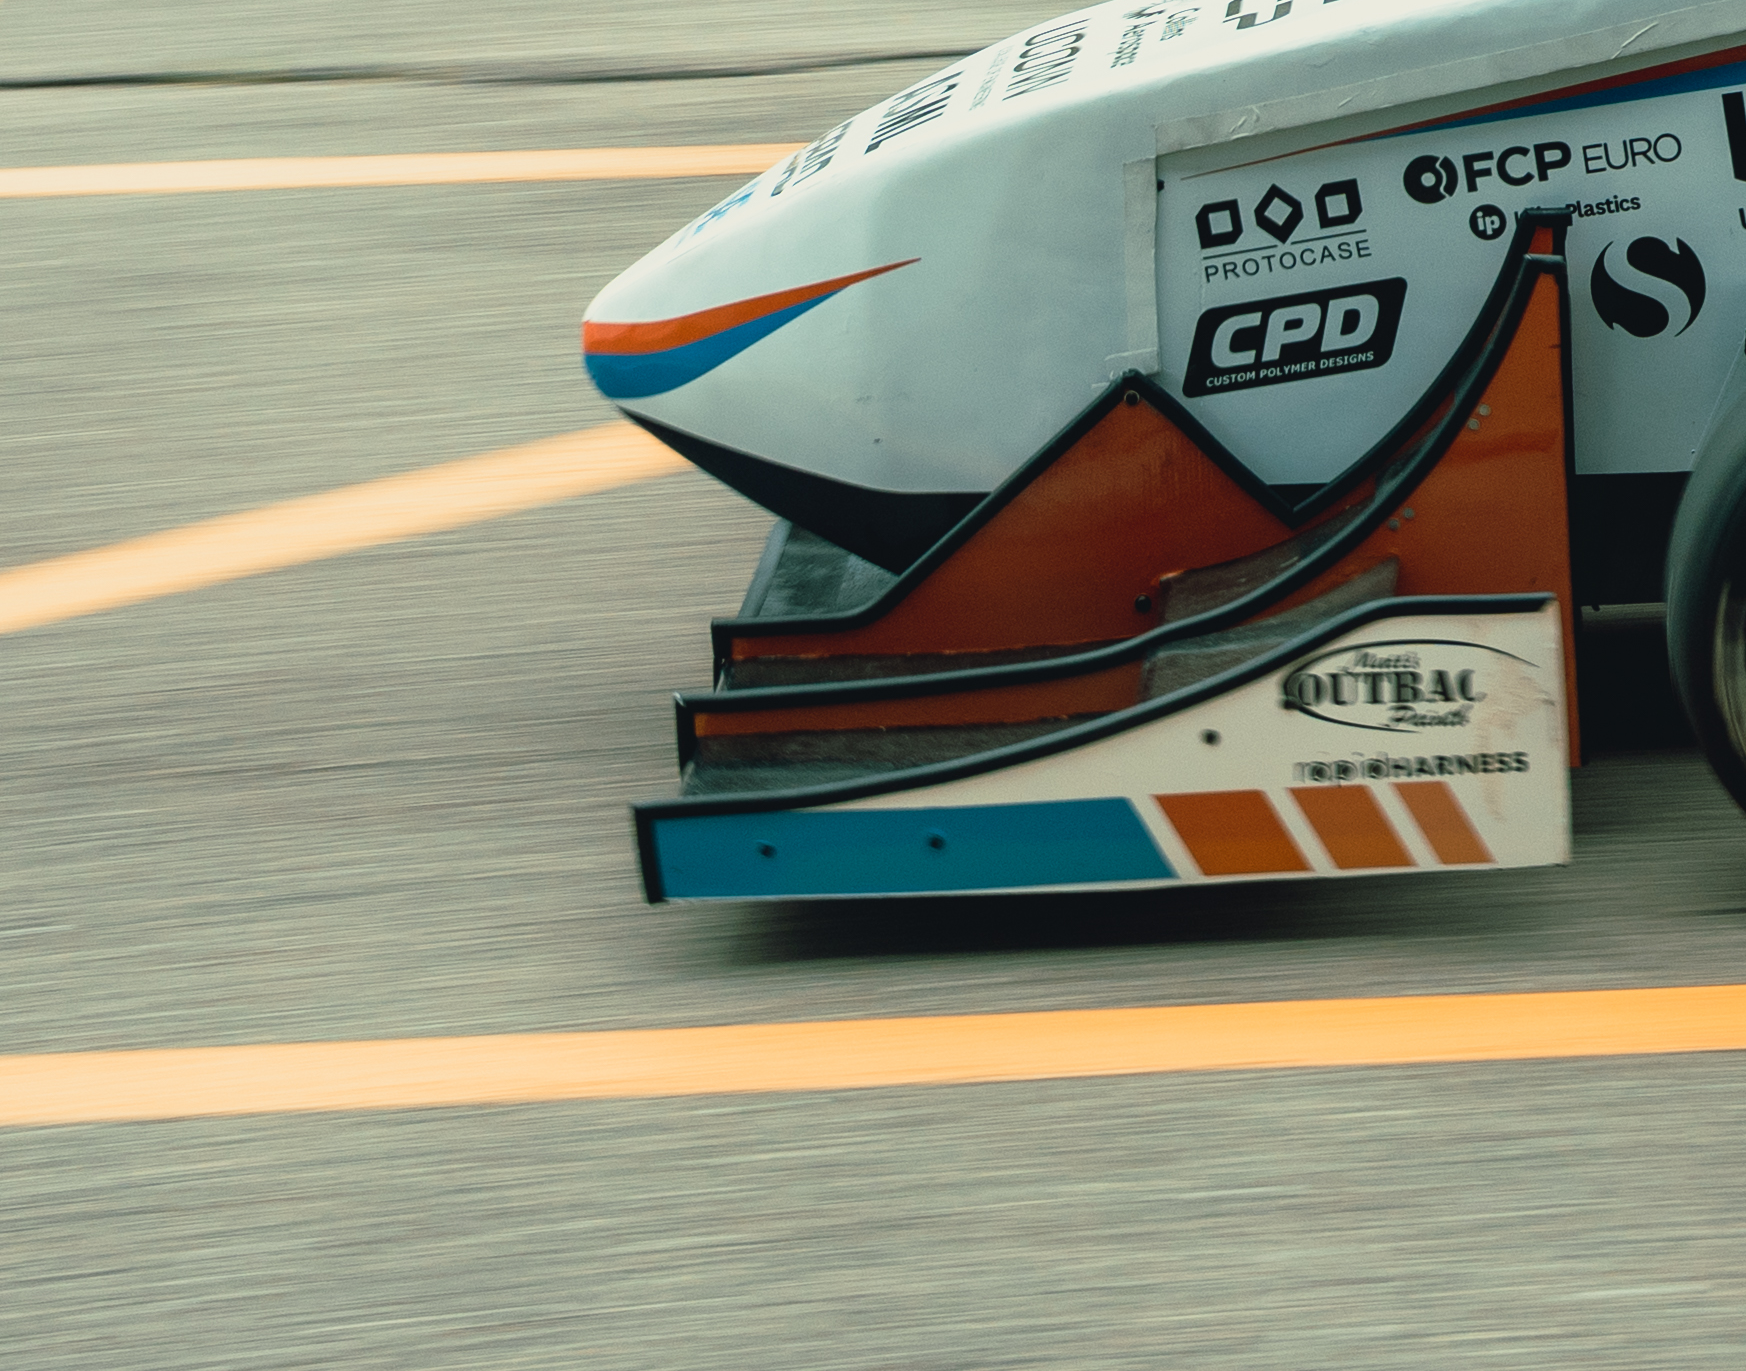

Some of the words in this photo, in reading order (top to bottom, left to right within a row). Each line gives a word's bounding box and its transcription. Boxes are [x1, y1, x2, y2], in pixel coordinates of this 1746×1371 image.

[1003, 18, 1093, 101] UCONN
[1463, 140, 1572, 193] FCP
[1582, 132, 1682, 175] EURO
[1565, 194, 1642, 219] Plastics
[1204, 238, 1373, 284] PROTOCASE
[1210, 293, 1381, 369] CPD
[1206, 369, 1257, 388] CUSTOM
[1260, 360, 1317, 380] POLYMER
[1319, 350, 1375, 373] DESIGNS
